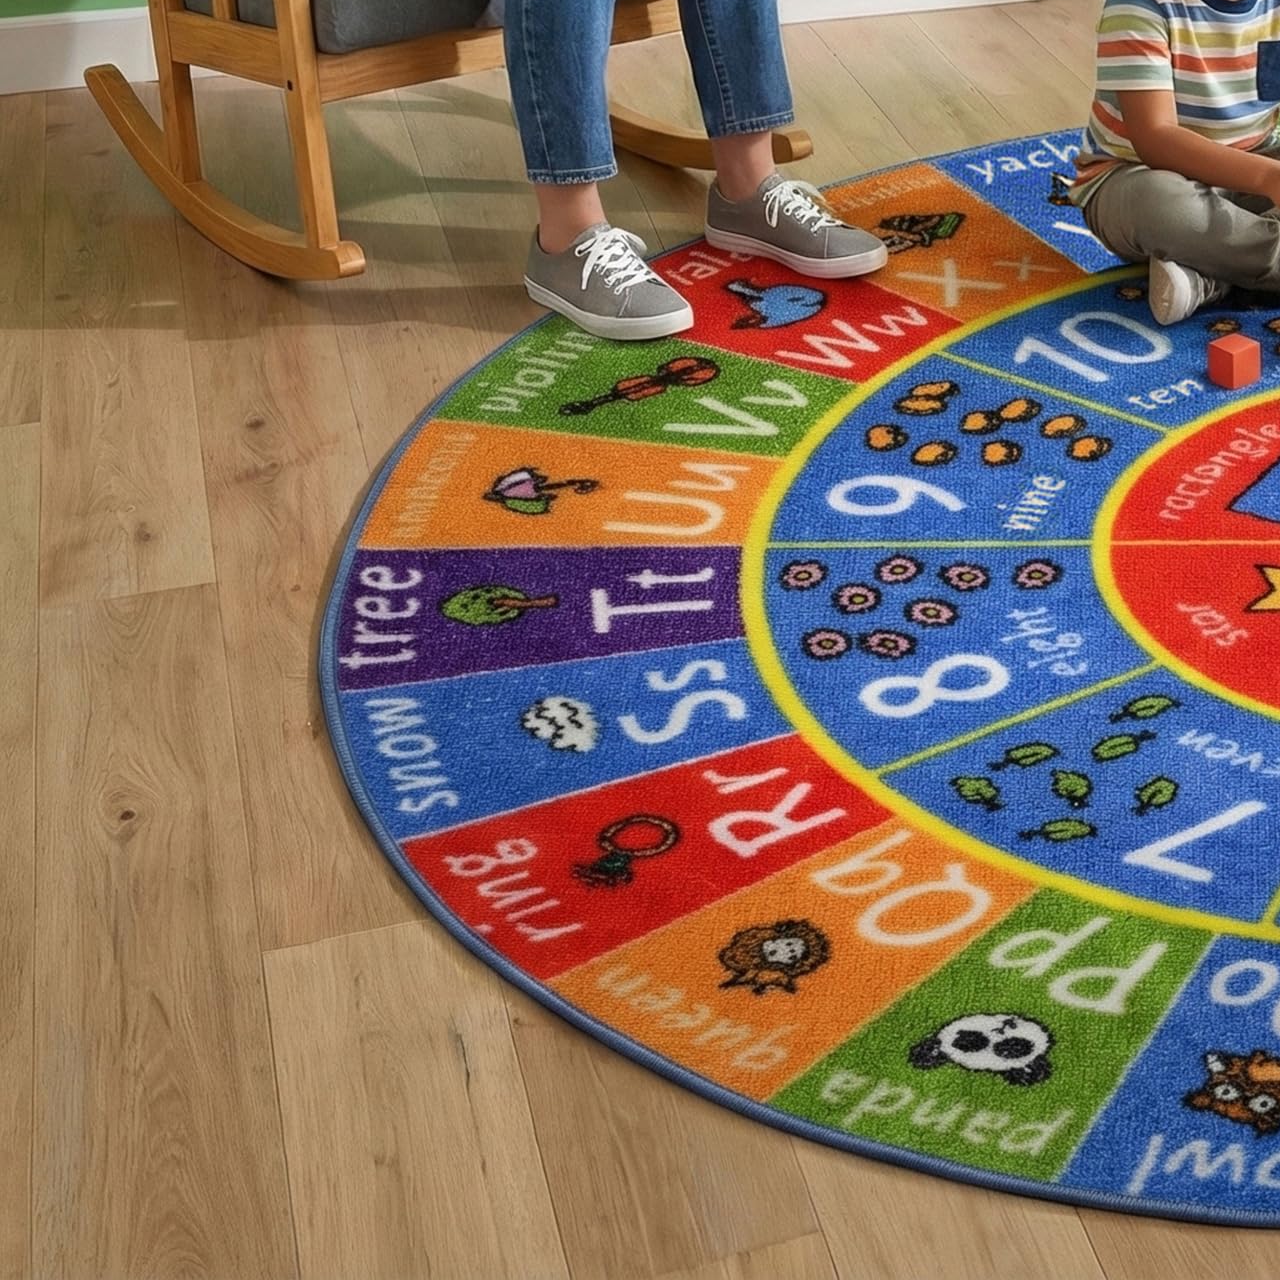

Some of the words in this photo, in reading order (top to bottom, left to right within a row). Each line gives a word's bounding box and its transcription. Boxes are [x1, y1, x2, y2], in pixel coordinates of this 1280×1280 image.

[967, 140, 1081, 184] yach
[776, 302, 928, 370] Ww
[1015, 311, 1171, 383] 10
[664, 378, 809, 437] Vv
[1129, 376, 1204, 412] ten
[603, 460, 750, 537] Uu
[826, 474, 967, 517] 9
[998, 472, 1067, 534] nine
[340, 565, 422, 669] tree
[592, 567, 715, 634] Tt
[618, 659, 746, 744] Ss
[858, 654, 1011, 717] 8
[364, 696, 460, 814] snow
[704, 767, 847, 858] Rr
[1123, 799, 1269, 884] 7
[443, 837, 582, 942] ring
[809, 828, 993, 947] Qq
[989, 917, 1169, 1016] Pp
[821, 1068, 1074, 1158] panda
